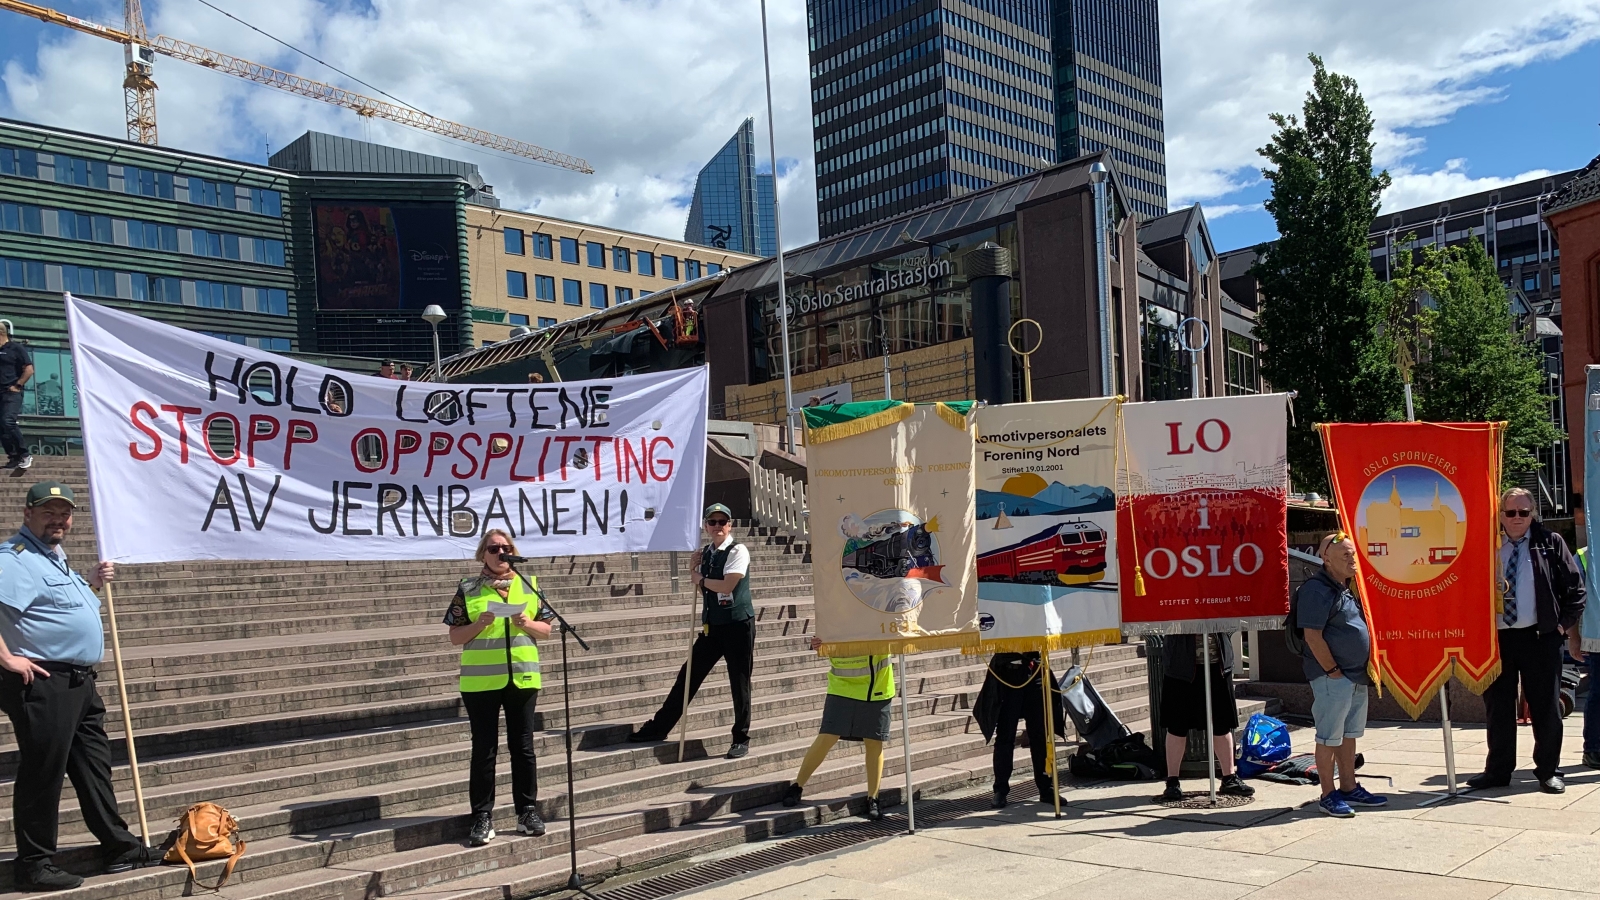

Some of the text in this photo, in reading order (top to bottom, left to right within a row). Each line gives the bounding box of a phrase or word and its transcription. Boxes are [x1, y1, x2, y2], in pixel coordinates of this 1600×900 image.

[800, 258, 950, 314] Oslo Sentralstasjon
[204, 351, 613, 430] HOLD LØFTENE
[27, 443, 65, 456] GON
[129, 401, 674, 484] STOPP OPPSPLITTING
[1165, 418, 1232, 456] LO
[928, 462, 970, 473] FORENING
[984, 445, 1080, 462] Forening Nord
[1363, 451, 1458, 477] OSLO SPORVEIERS
[1026, 464, 1064, 472] 19.01.2001
[201, 473, 628, 538] AV JERNBANEN!
[1197, 497, 1211, 530] i
[1144, 542, 1264, 580] OSLO
[1366, 572, 1459, 600] ARBEIDERFORENING
[1159, 598, 1190, 606] STIFTET
[1235, 595, 1251, 603] 1920
[1407, 629, 1441, 640] Stiftet
[1444, 628, 1465, 638] 1894
